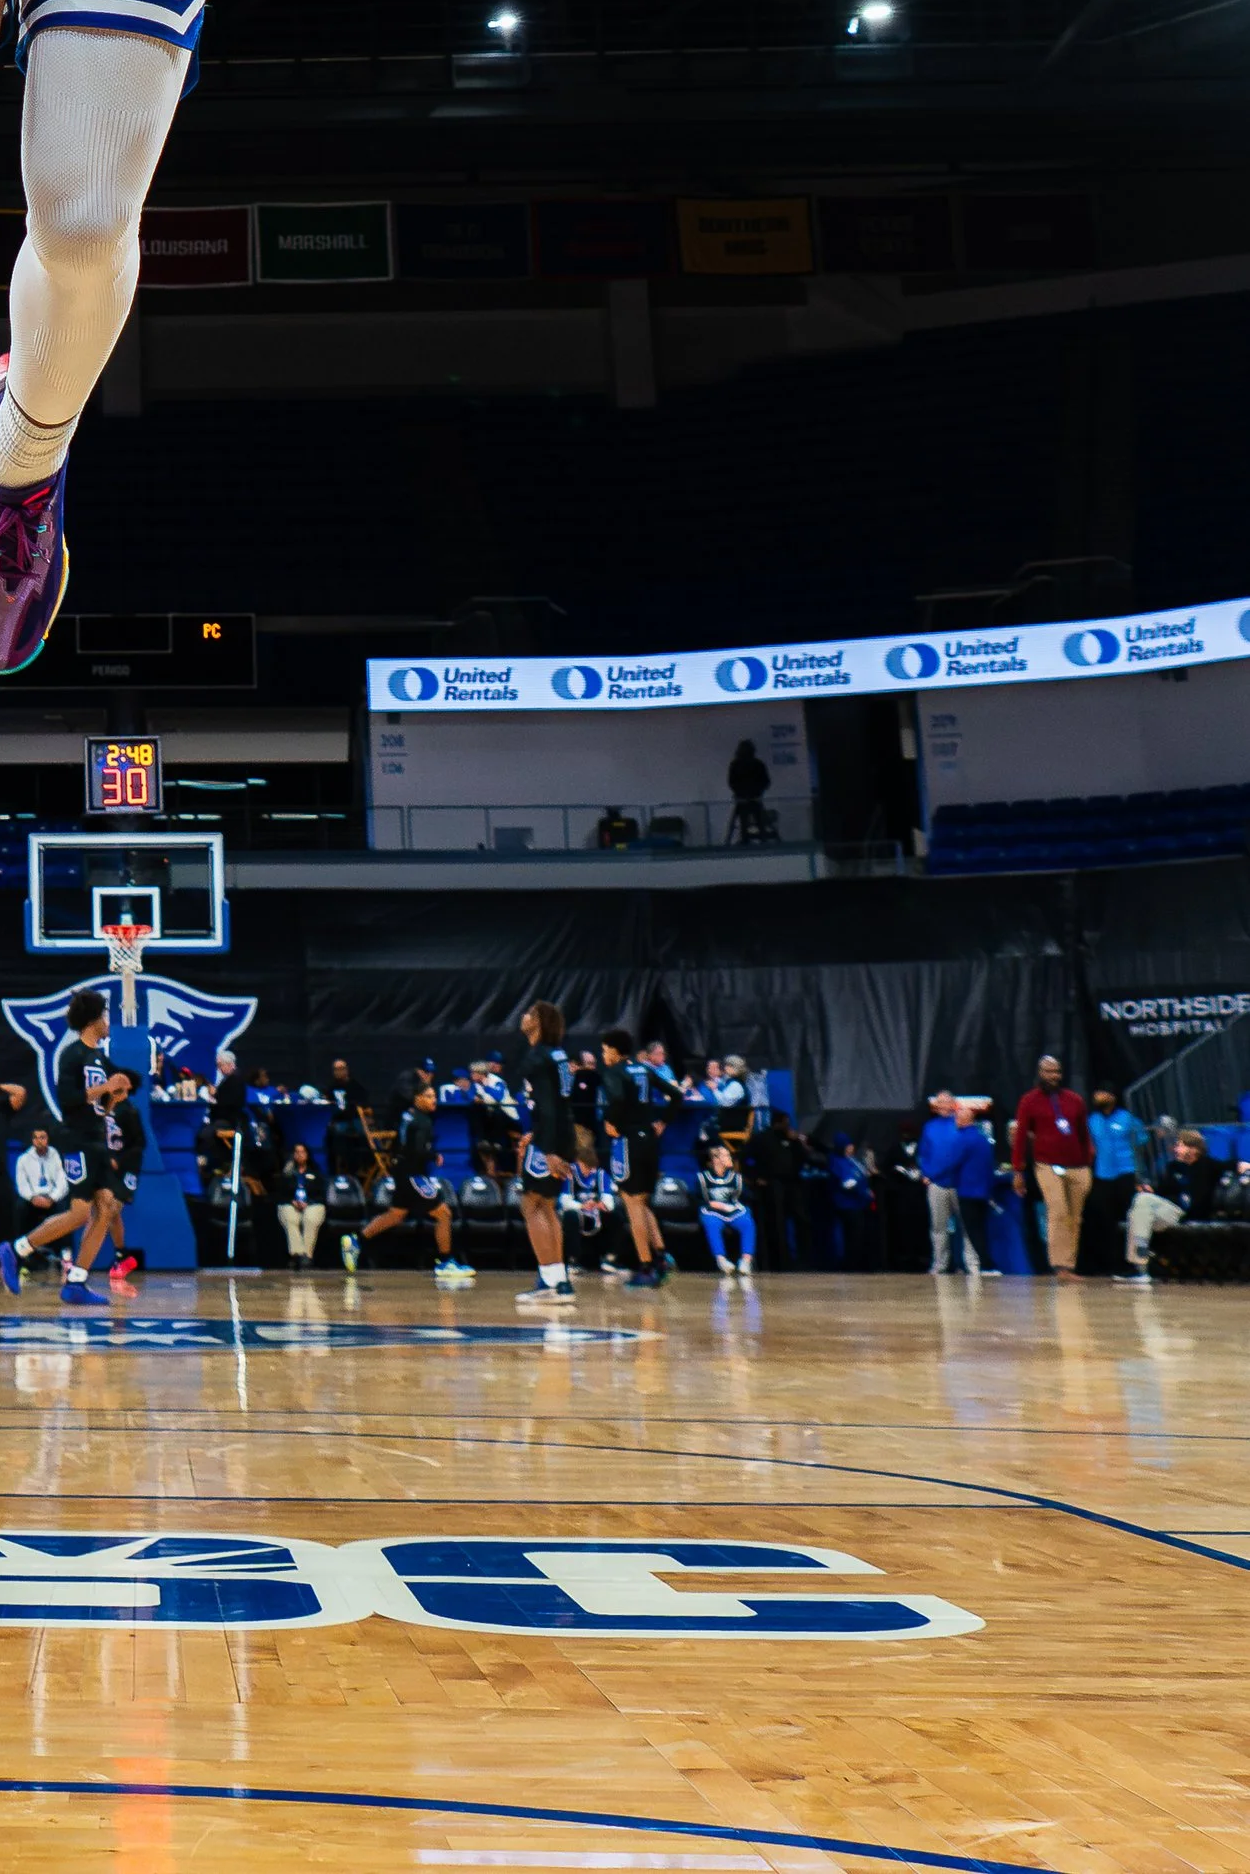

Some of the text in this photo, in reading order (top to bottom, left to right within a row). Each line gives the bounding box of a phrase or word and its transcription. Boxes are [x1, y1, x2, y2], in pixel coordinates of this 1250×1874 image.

[141, 238, 229, 257] LOUISIANA
[278, 233, 370, 251] MARSHALL
[202, 622, 222, 639] PC
[1124, 615, 1196, 643] United
[944, 636, 1020, 658] United
[1127, 638, 1205, 662] Rentals
[771, 650, 845, 672] United
[946, 656, 1028, 677] Rentals
[444, 666, 513, 684] United
[607, 662, 676, 682] United
[772, 669, 852, 689] Rentals
[444, 684, 518, 702] Rentals
[608, 681, 683, 700] Rentals
[106, 743, 154, 767] 2:48
[102, 767, 148, 806] 30
[1100, 994, 1250, 1021] NORTHSIDE
